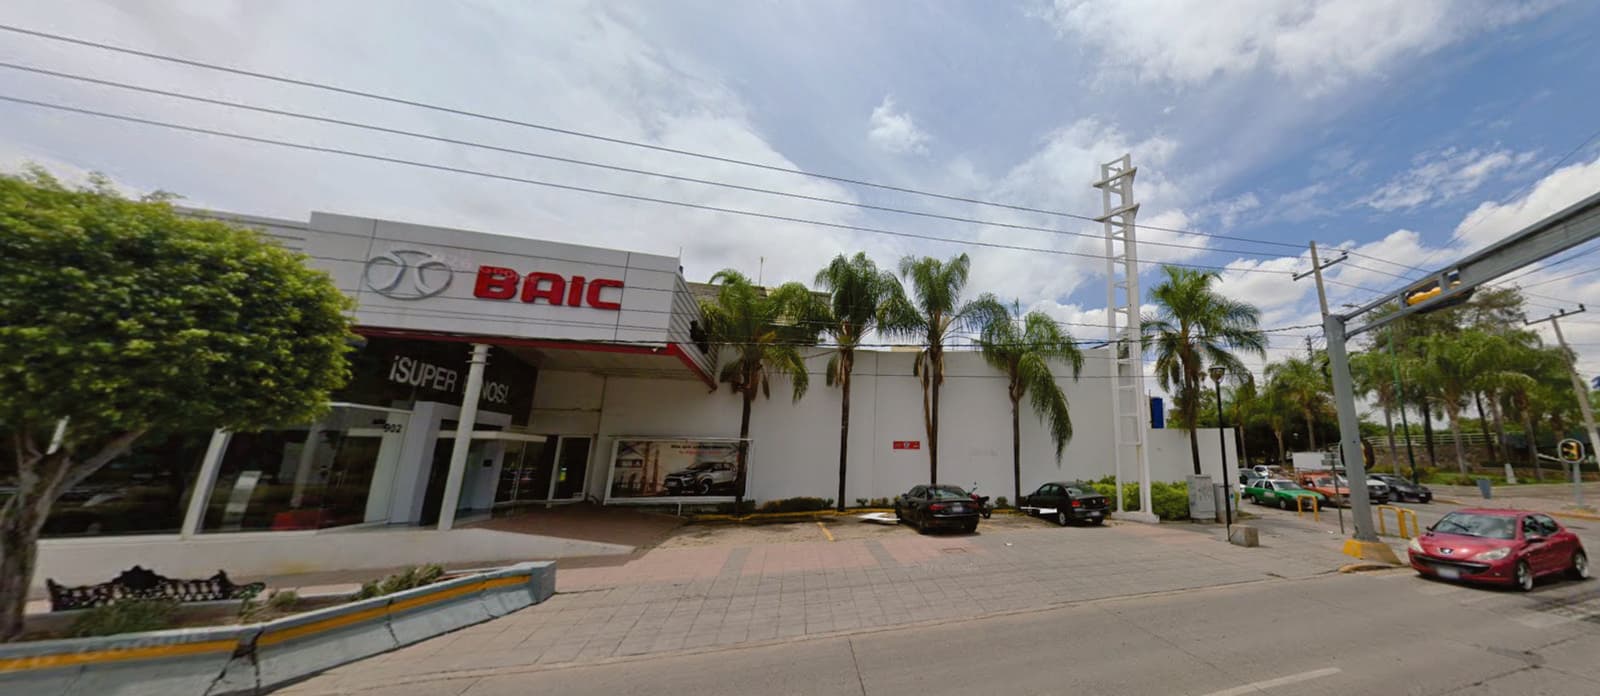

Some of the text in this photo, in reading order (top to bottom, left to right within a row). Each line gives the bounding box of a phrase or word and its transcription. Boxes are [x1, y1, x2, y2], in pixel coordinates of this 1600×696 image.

[473, 265, 625, 312] BAIC
[389, 355, 458, 393] ¡SUPER
[383, 423, 402, 433] 902
